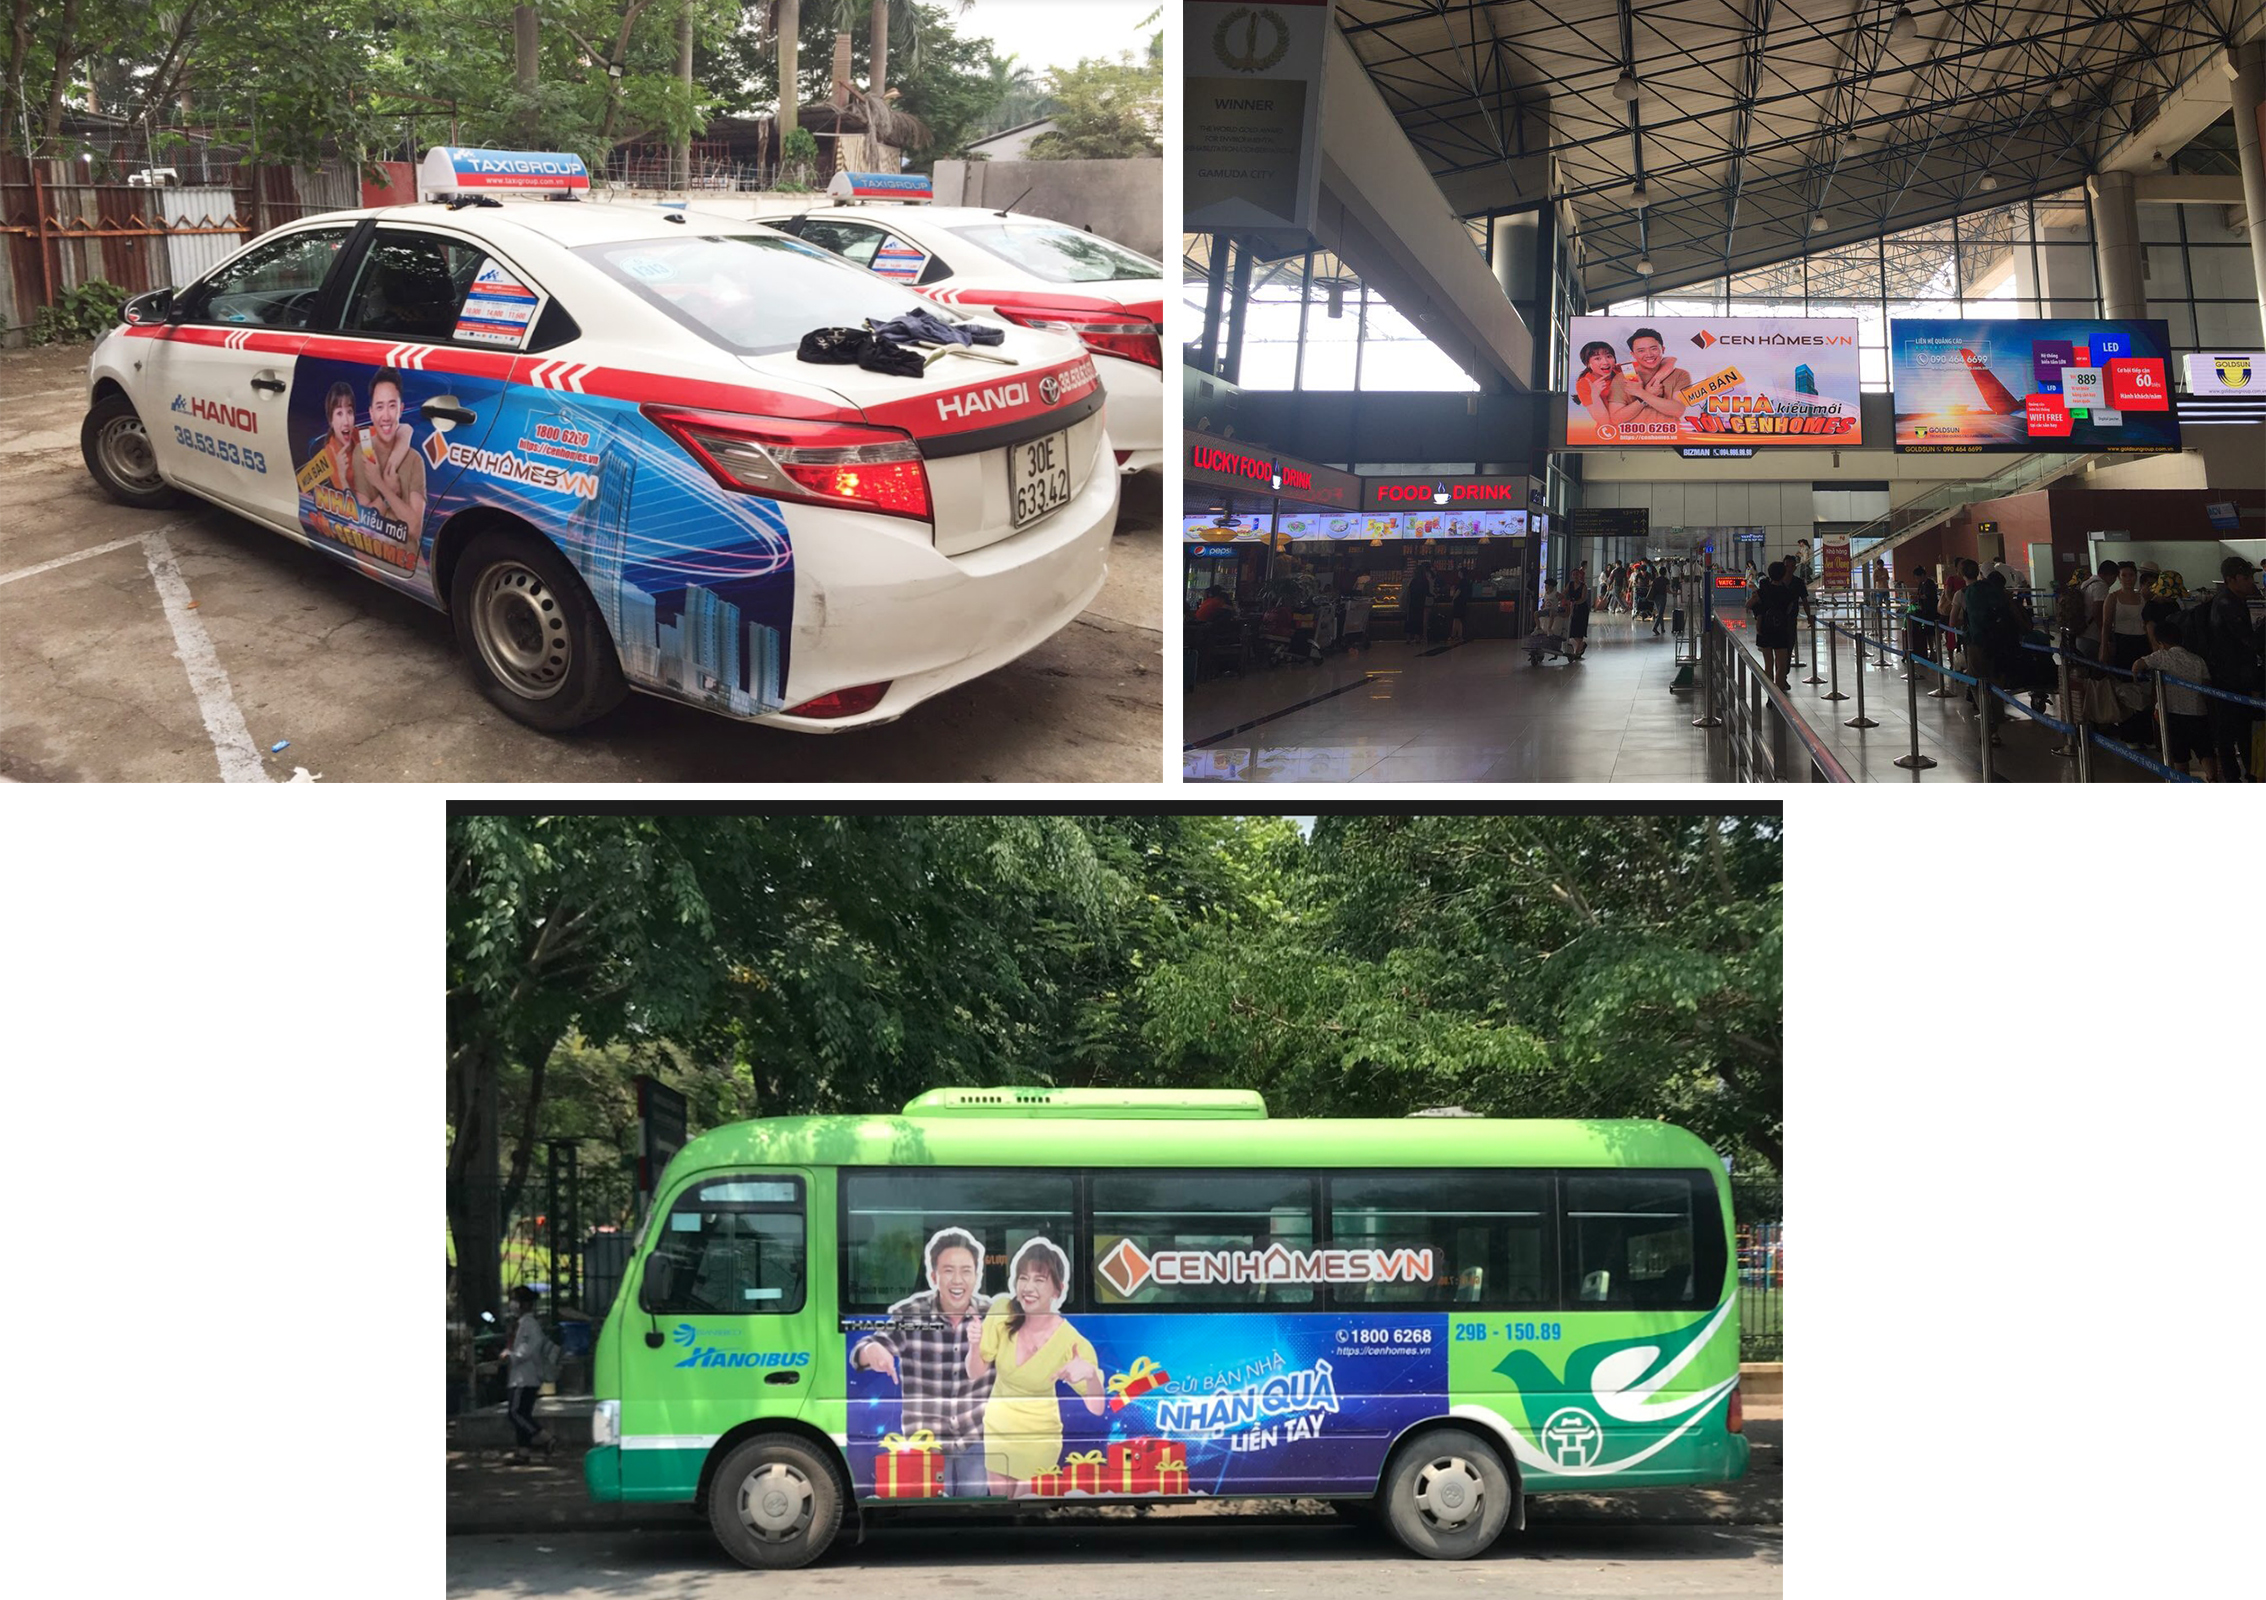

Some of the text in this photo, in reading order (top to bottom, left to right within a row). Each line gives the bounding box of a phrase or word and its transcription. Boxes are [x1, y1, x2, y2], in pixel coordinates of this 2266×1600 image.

[1215, 98, 1274, 111] WINNER
[468, 159, 582, 174] TAXIGROUP
[1198, 169, 1275, 179] GAMUDA CITY
[485, 177, 565, 185] www.taxigroup.com.vn
[861, 180, 928, 190] TAXIGROUP
[2103, 342, 2119, 352] LED
[1688, 371, 1738, 402] MUA BÁN
[2077, 374, 2096, 385] 889
[2136, 374, 2151, 387] 60
[936, 382, 1029, 421] HANOI
[1708, 392, 1843, 416] NHÀ kiểu mới
[192, 397, 258, 434] HANOI
[534, 424, 590, 446] 1800 6268
[1619, 424, 1676, 433] 1800 6268
[1731, 416, 1857, 435] CENHOMES
[174, 425, 267, 474] 38.53.53.53
[1027, 437, 1055, 477] 30E
[1194, 445, 1311, 490] LUCKY FOOD DRINK
[1017, 469, 1067, 520] 633.42
[1378, 485, 1512, 502] FOOD DRINK
[361, 510, 383, 530] kiểu
[385, 523, 408, 541] mới
[335, 523, 417, 571] CENHOMES
[1209, 546, 1233, 556] pepsi
[841, 1320, 896, 1331] THACO
[1455, 1323, 1487, 1341] 29B
[1505, 1323, 1561, 1341] 150.89
[1351, 1330, 1432, 1343] 1800 6268
[674, 1347, 810, 1368] HANOIBUS
[1336, 1347, 1431, 1356] https://cenhomes.vn
[1164, 1349, 1286, 1393] GỬI BÁN NHÀ
[1157, 1358, 1340, 1438] NHẬN QUÀ
[1284, 1412, 1325, 1443] TAY
